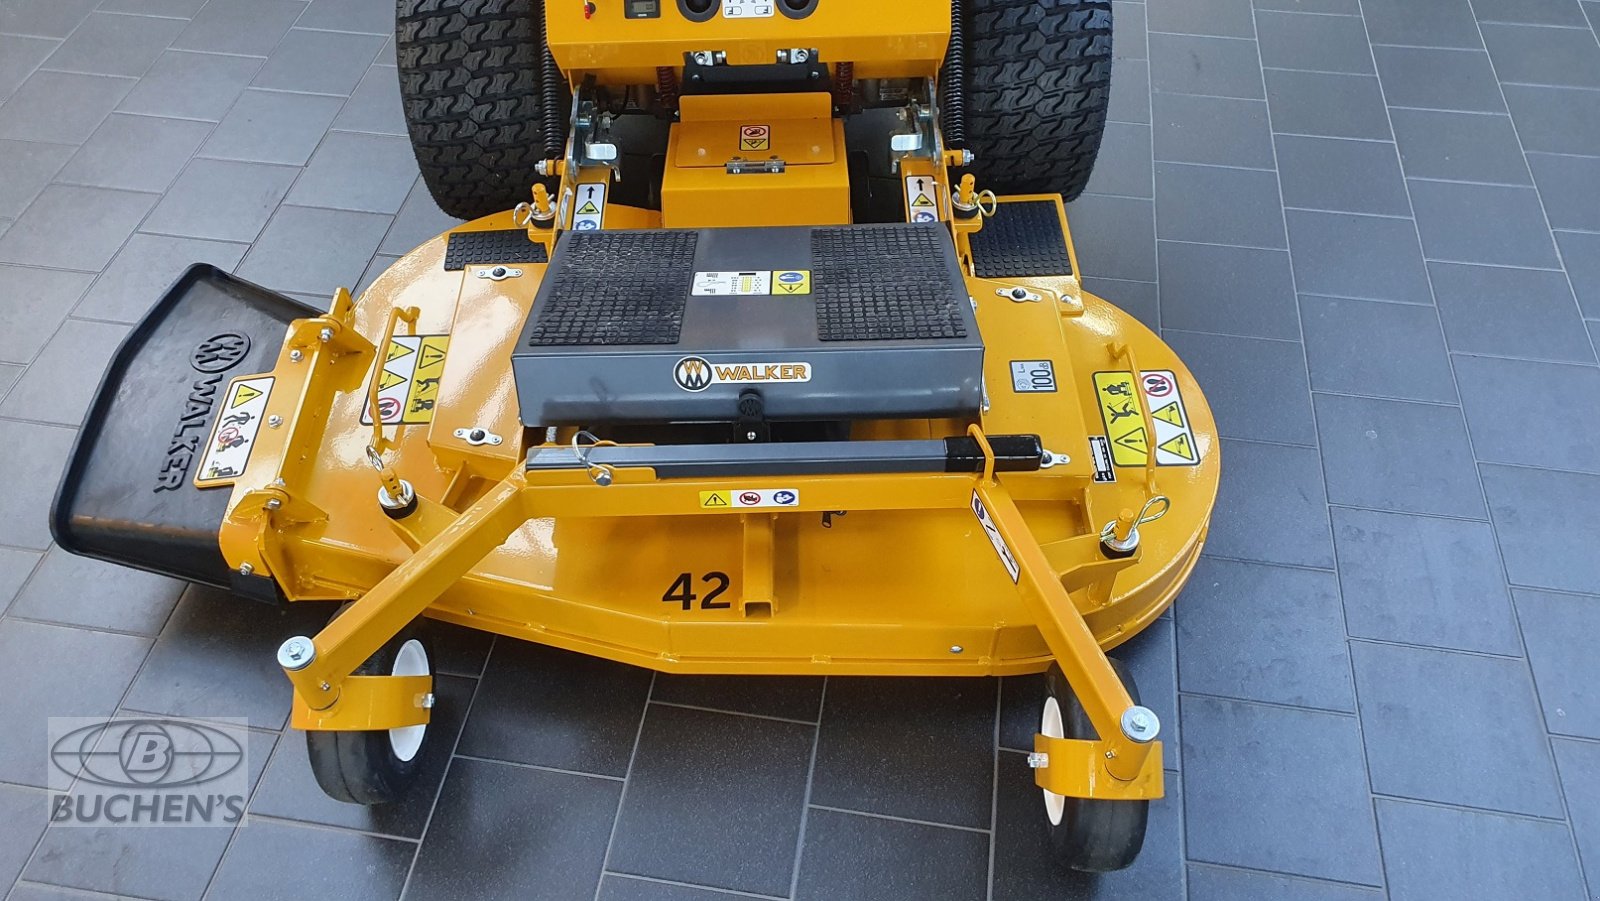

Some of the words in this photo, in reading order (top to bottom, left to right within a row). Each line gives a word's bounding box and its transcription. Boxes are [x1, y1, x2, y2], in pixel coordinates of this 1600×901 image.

[714, 365, 807, 380] WALKER
[1030, 369, 1053, 390] 100
[153, 374, 224, 493] WALKER
[662, 571, 731, 611] 42
